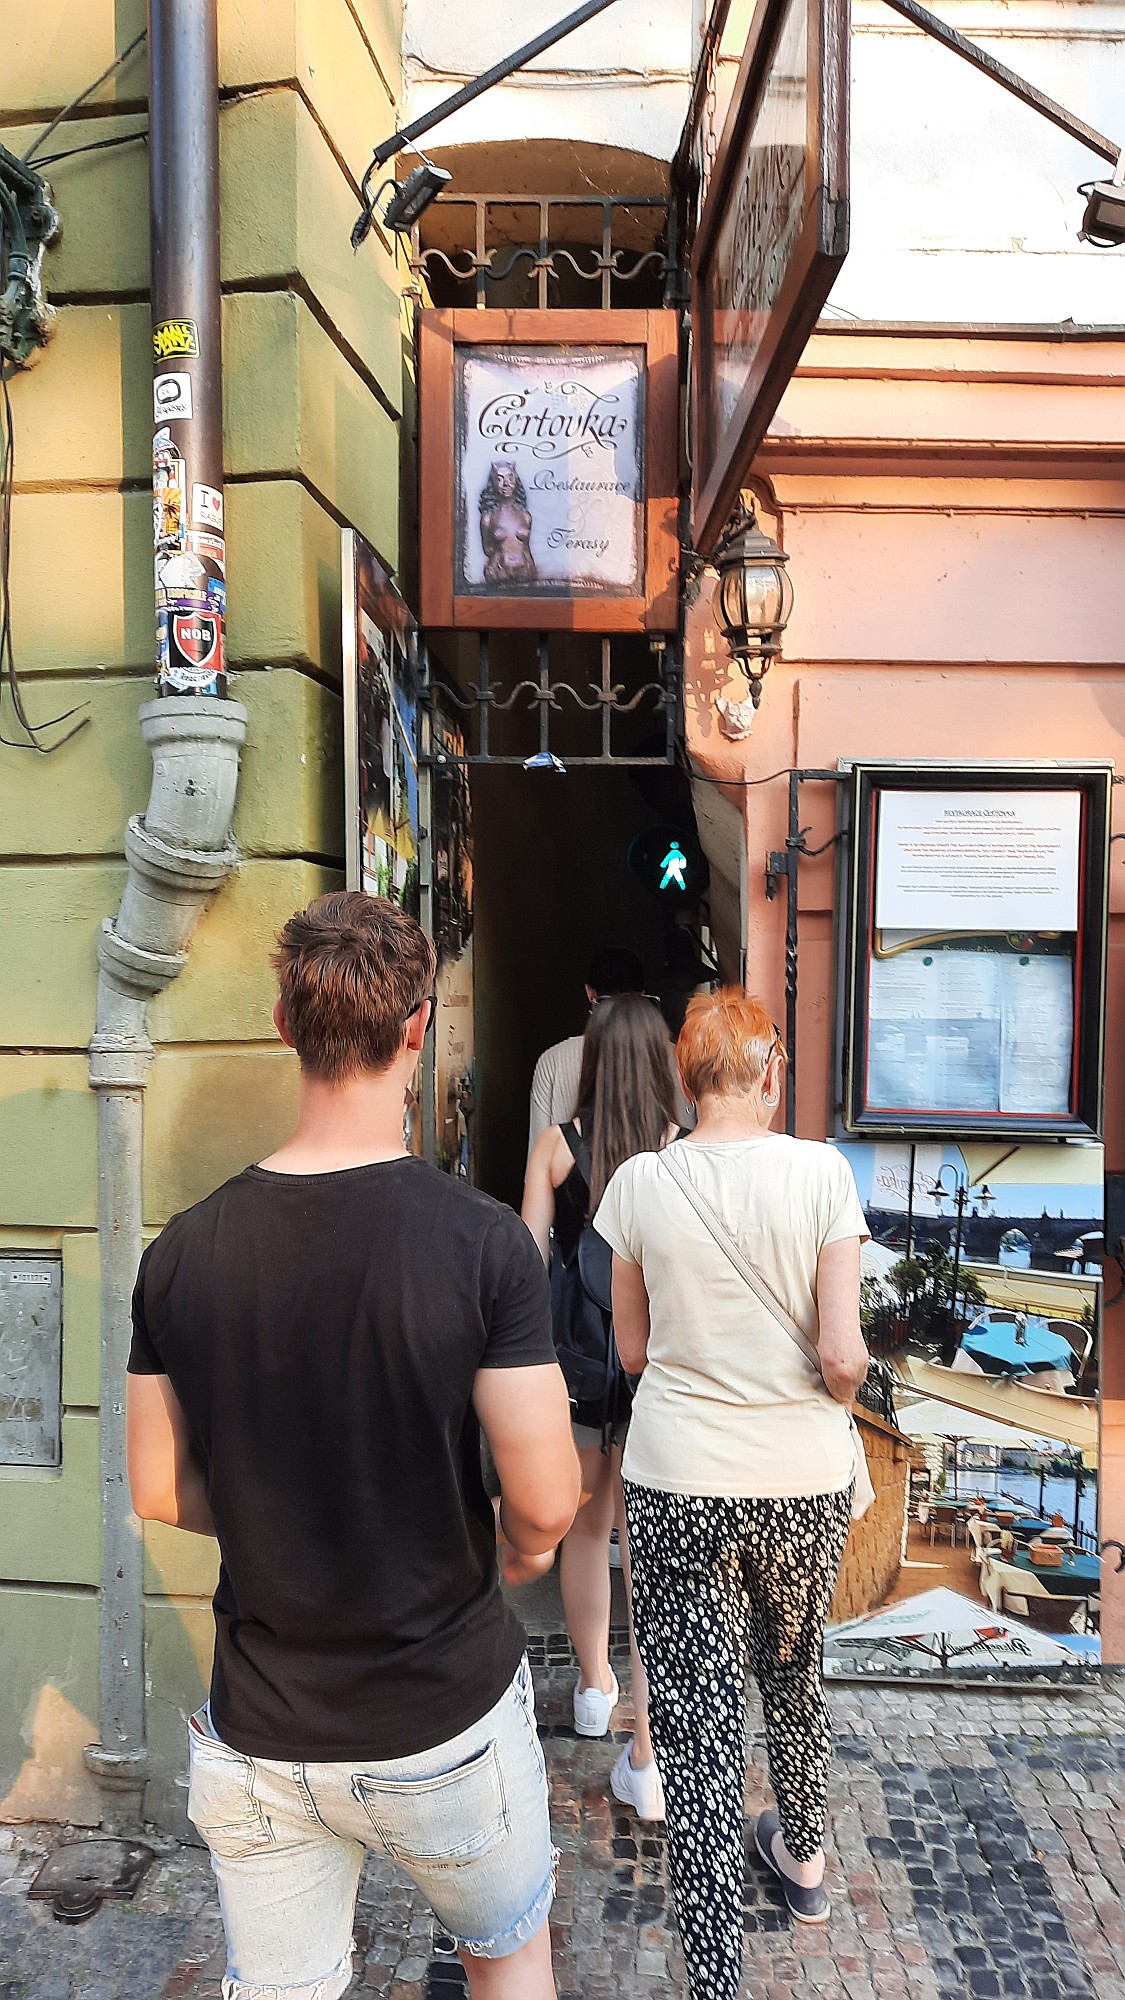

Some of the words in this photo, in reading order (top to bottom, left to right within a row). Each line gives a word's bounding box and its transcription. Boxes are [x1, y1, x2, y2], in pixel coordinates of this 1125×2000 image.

[529, 469, 631, 493] Restaurace
[546, 527, 610, 558] Terasy
[180, 627, 212, 642] NOB
